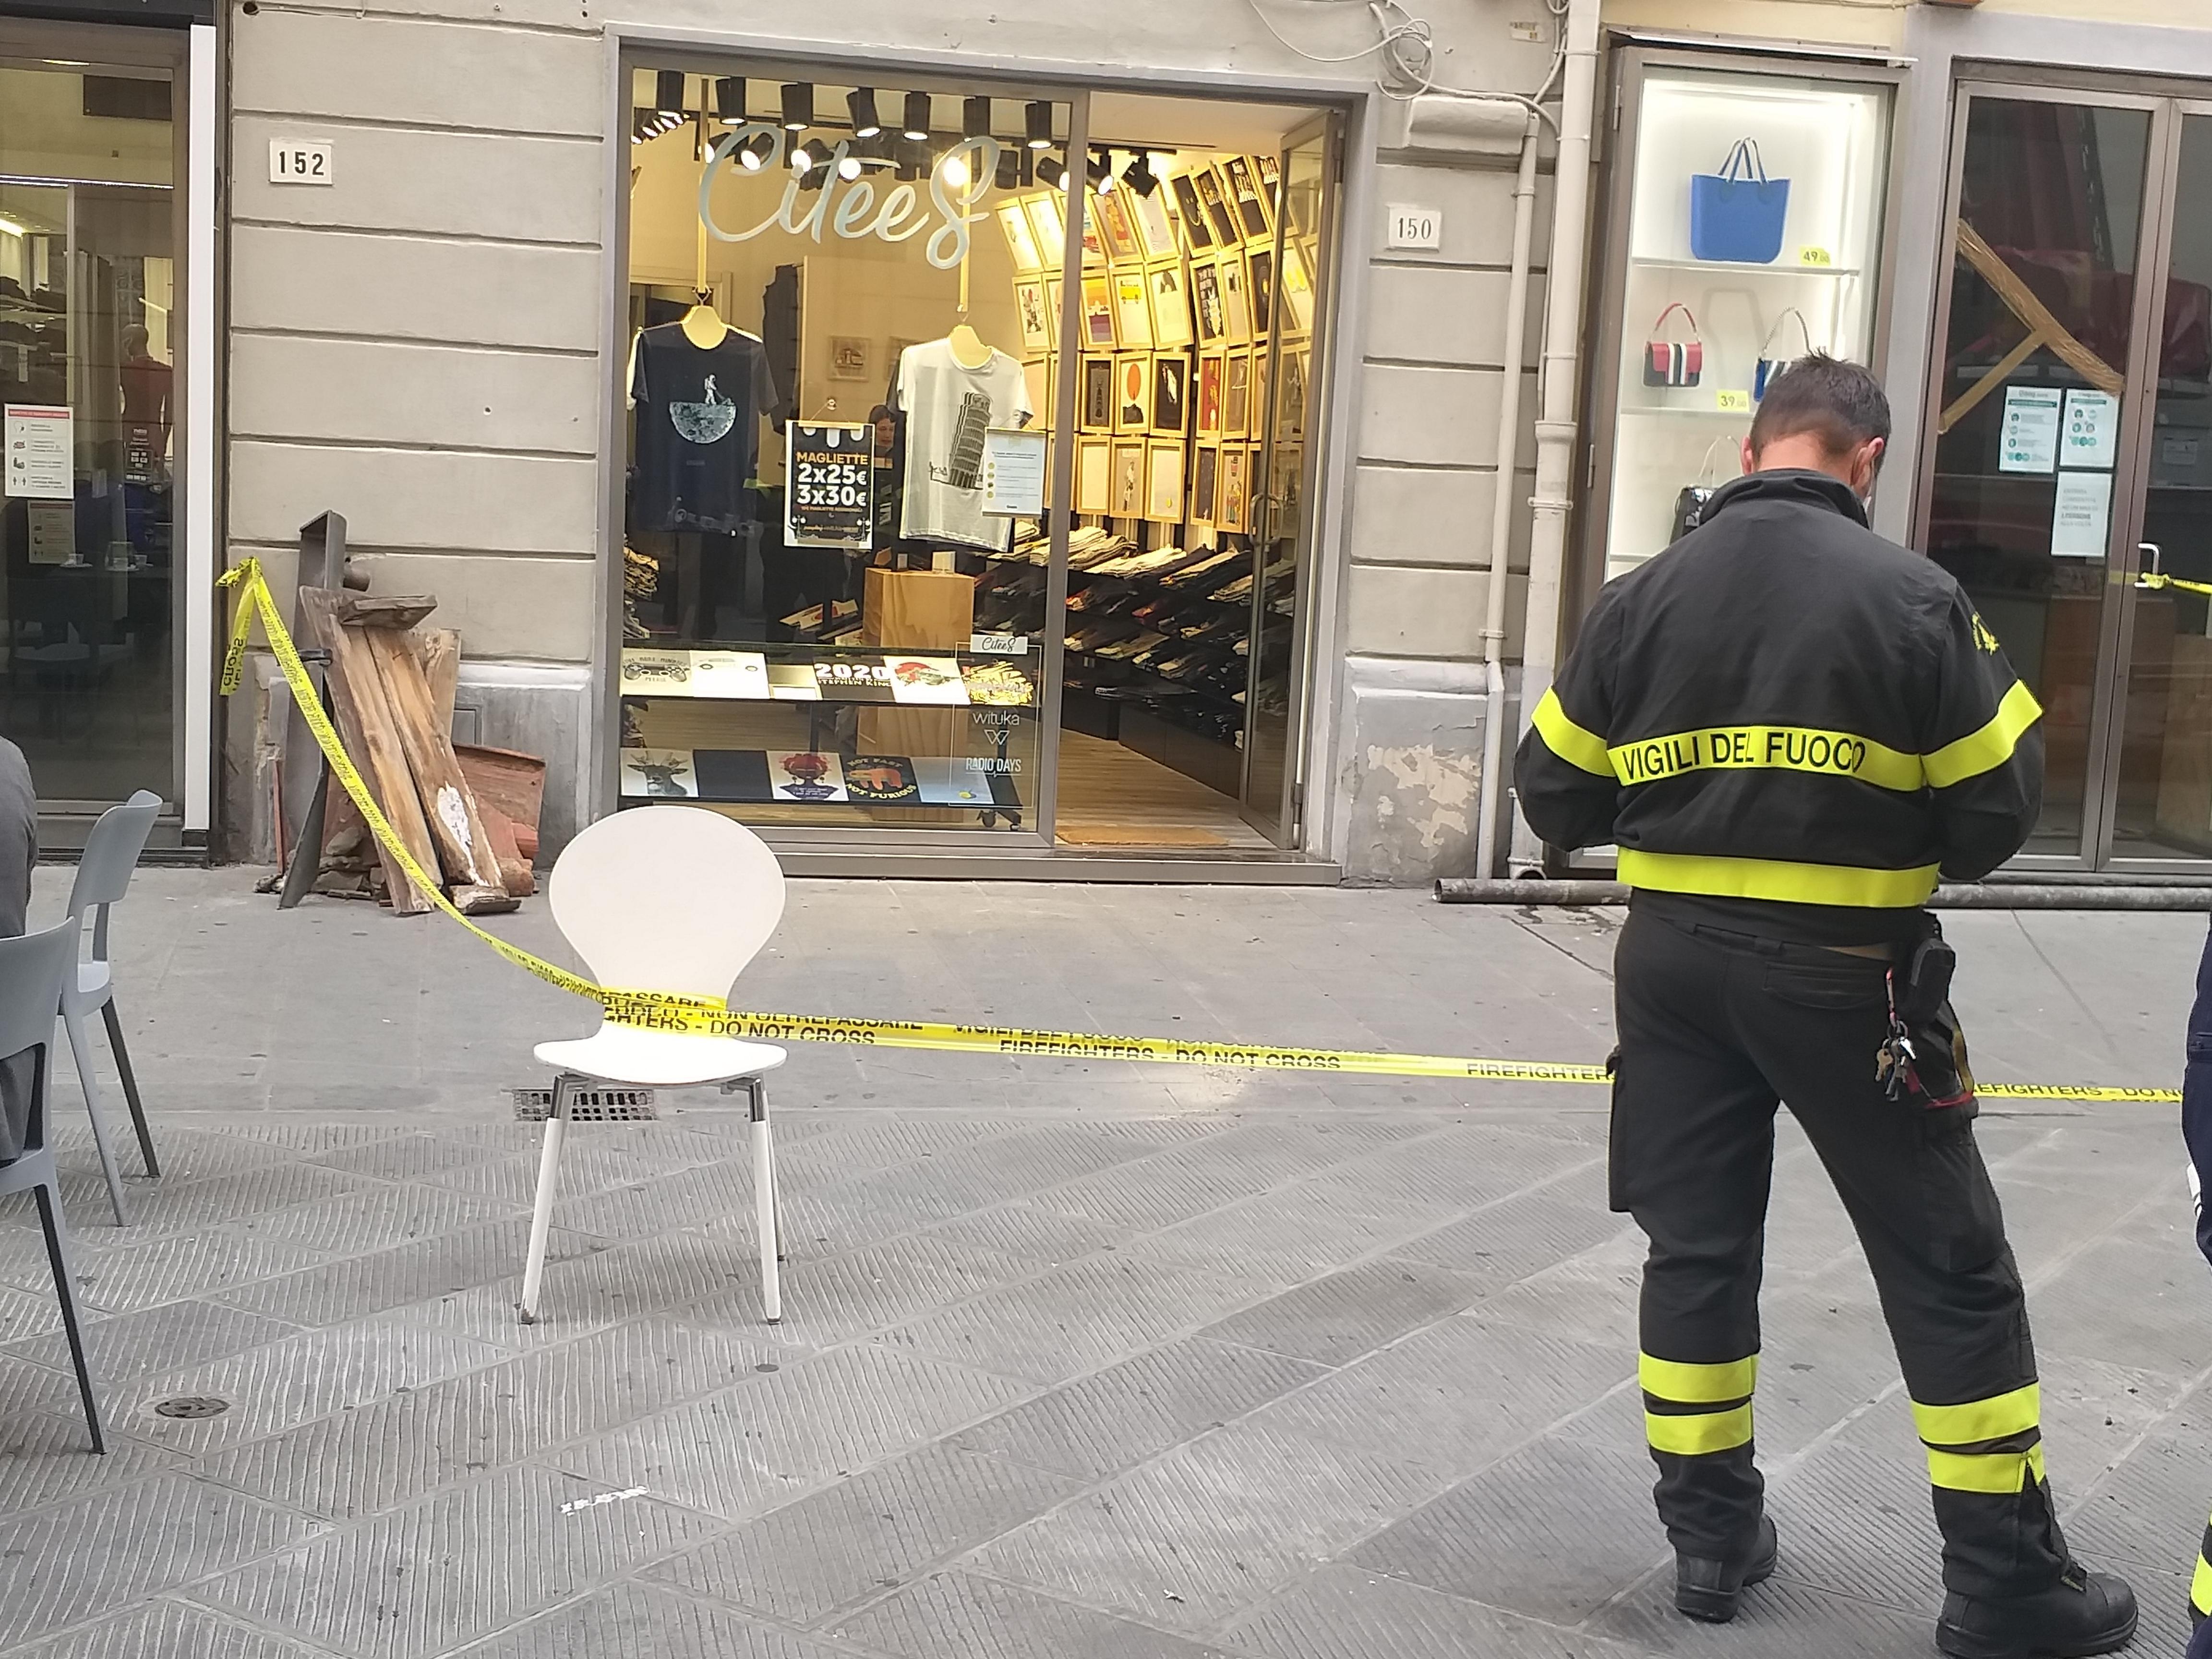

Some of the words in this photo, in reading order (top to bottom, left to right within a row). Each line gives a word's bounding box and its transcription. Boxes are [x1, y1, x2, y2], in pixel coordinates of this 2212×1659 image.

[279, 151, 325, 176] 152
[1397, 216, 1431, 240] 150
[796, 451, 868, 465] MAGLIETTE
[797, 463, 867, 485] 2x25€
[796, 484, 867, 506] 3x30€
[814, 663, 890, 680] 2020
[972, 709, 1020, 726] wituka
[965, 757, 994, 771] RADIO
[996, 758, 1022, 772] DAYS
[1622, 736, 1700, 780] VIGILI
[1710, 732, 1755, 764] DEL
[1766, 732, 1866, 773] FUOCO
[845, 783, 868, 795] NOT
[869, 784, 917, 799] FURIOUS
[710, 1020, 742, 1035] DO
[748, 1022, 795, 1039] NOT
[800, 1026, 875, 1045] CROSS
[1176, 1049, 1206, 1062] DO
[1214, 1051, 1259, 1064] NOT
[1265, 1053, 1341, 1069] CROSS
[1467, 1063, 1615, 1081] FIREFIGHTER
